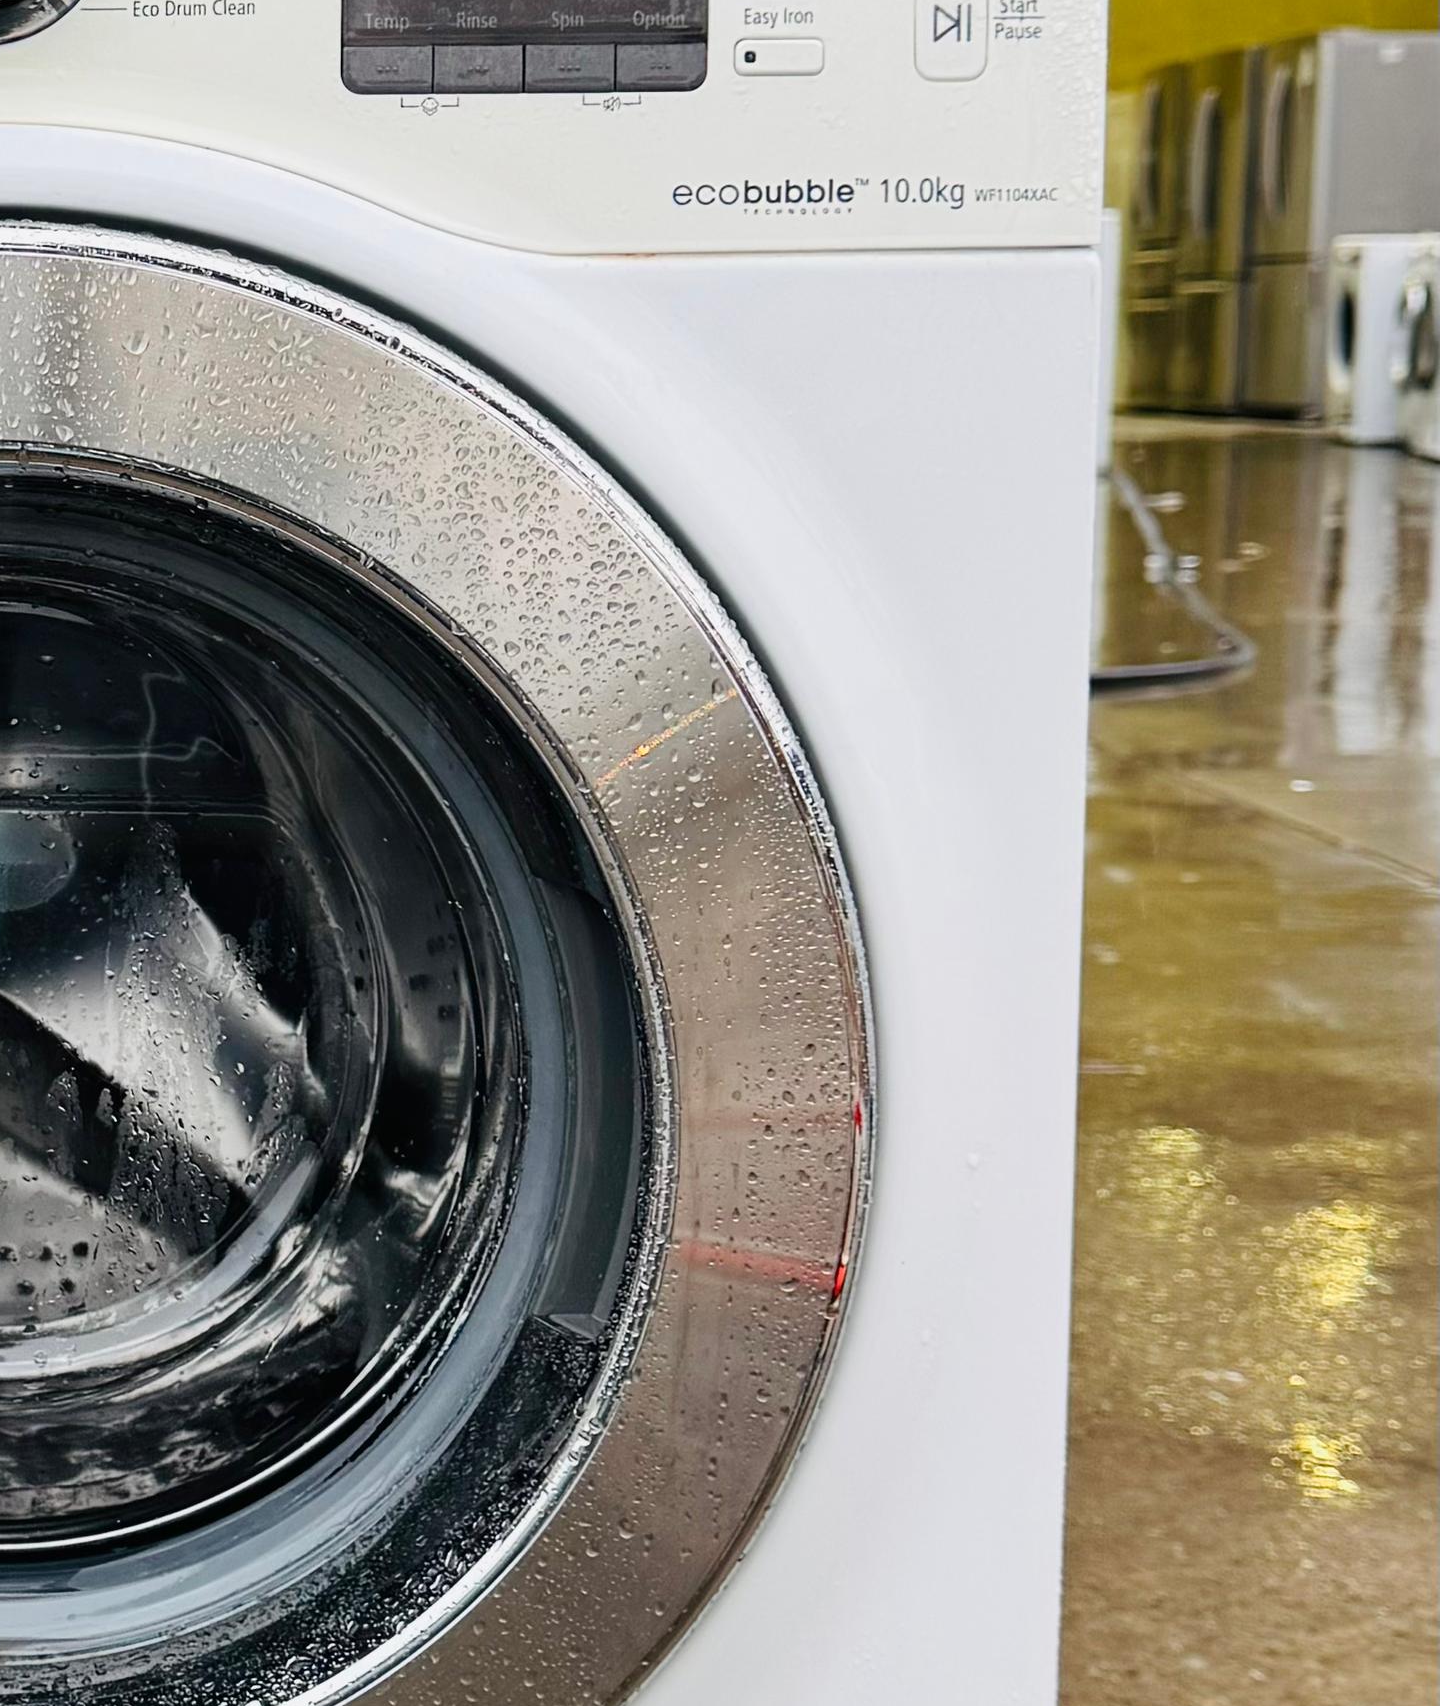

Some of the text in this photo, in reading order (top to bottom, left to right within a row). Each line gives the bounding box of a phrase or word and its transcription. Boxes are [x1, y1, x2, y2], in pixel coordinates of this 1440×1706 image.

[133, 0, 160, 17] Eco
[165, 0, 207, 16] Drum
[744, 7, 814, 28] Easy Iron
[364, 12, 410, 32] Temp
[456, 11, 498, 29] Rinse
[551, 10, 585, 31] Spin
[633, 9, 686, 30] Option
[994, 22, 1042, 40] Pause
[880, 177, 965, 210] 10.0kg
[974, 187, 1059, 202] WF1104XAC
